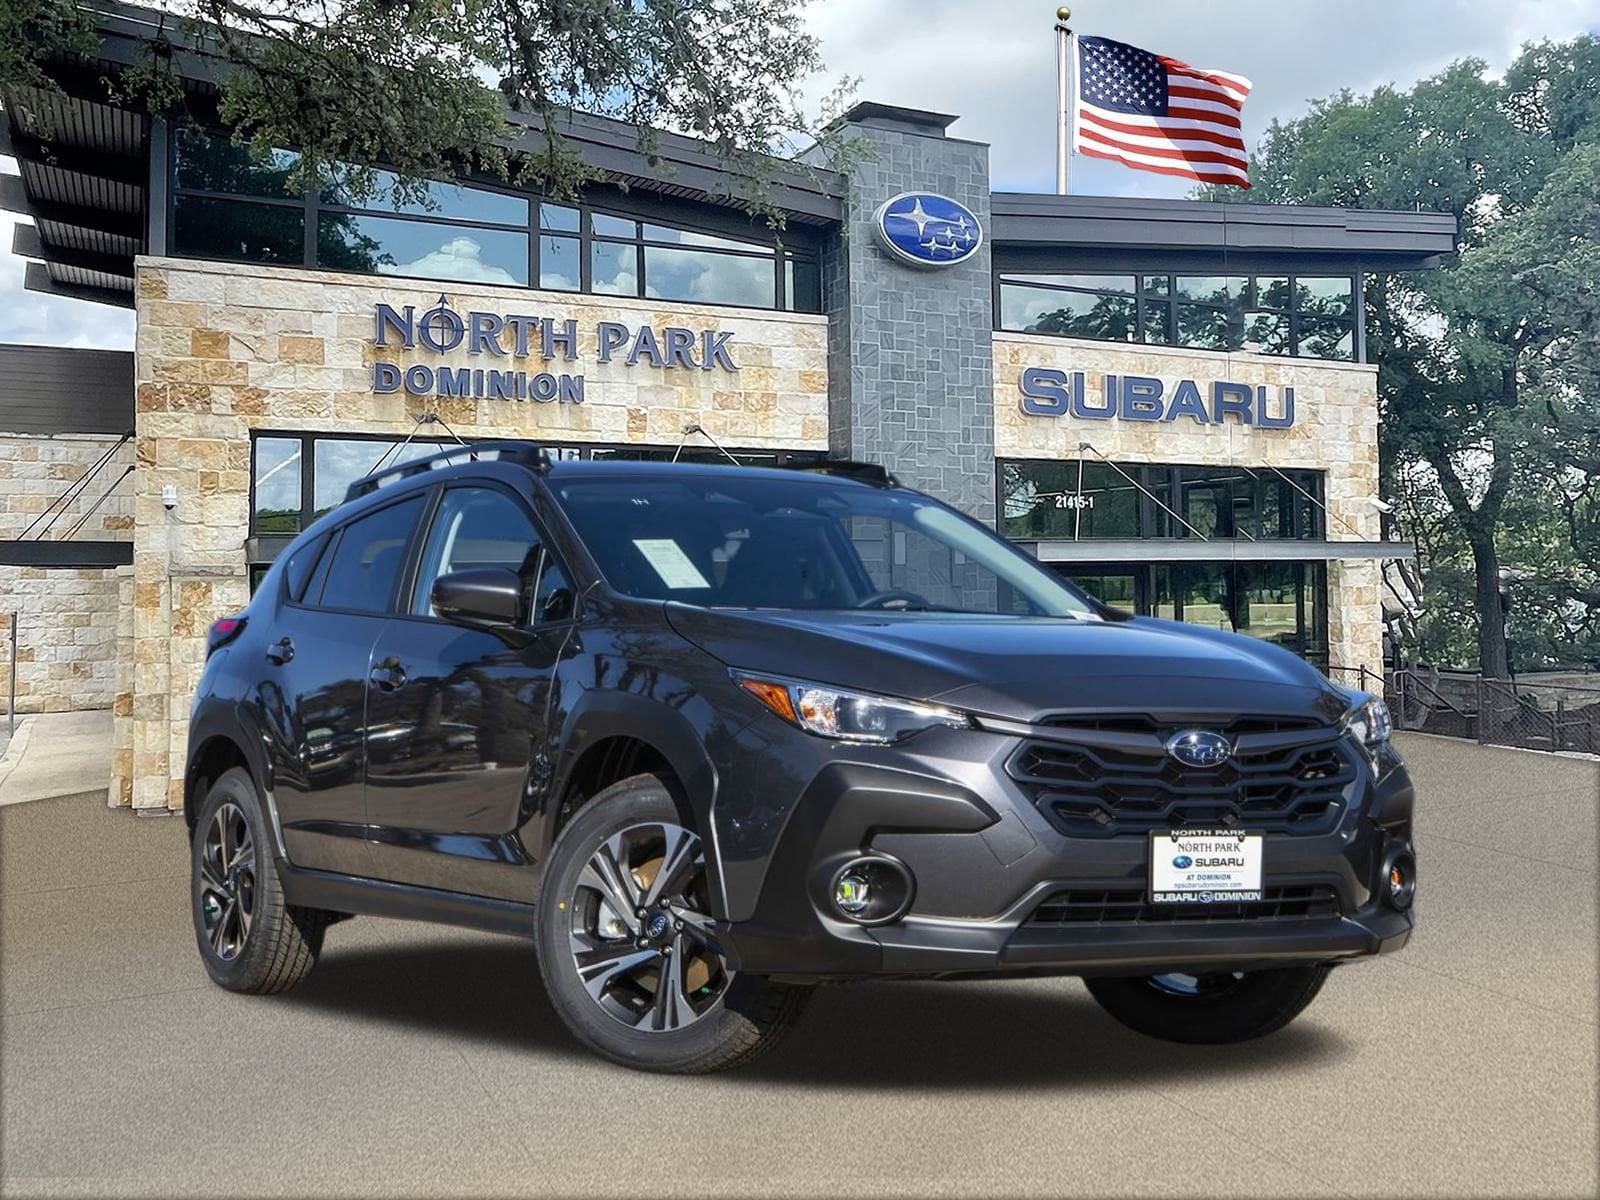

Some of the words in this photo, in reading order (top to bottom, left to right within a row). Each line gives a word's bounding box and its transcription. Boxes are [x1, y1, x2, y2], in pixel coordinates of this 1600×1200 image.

[374, 294, 580, 362] NORTH
[597, 320, 742, 372] PARK
[372, 362, 585, 404] DOMINION
[1019, 367, 1296, 430] SUBARU
[1055, 495, 1094, 509] 21415-1
[1177, 842, 1212, 852] NORTH
[1215, 843, 1241, 852] PARK
[1195, 858, 1245, 867] SUBARU
[1153, 892, 1198, 902] SUBARU
[1215, 892, 1261, 901] DOMINION
